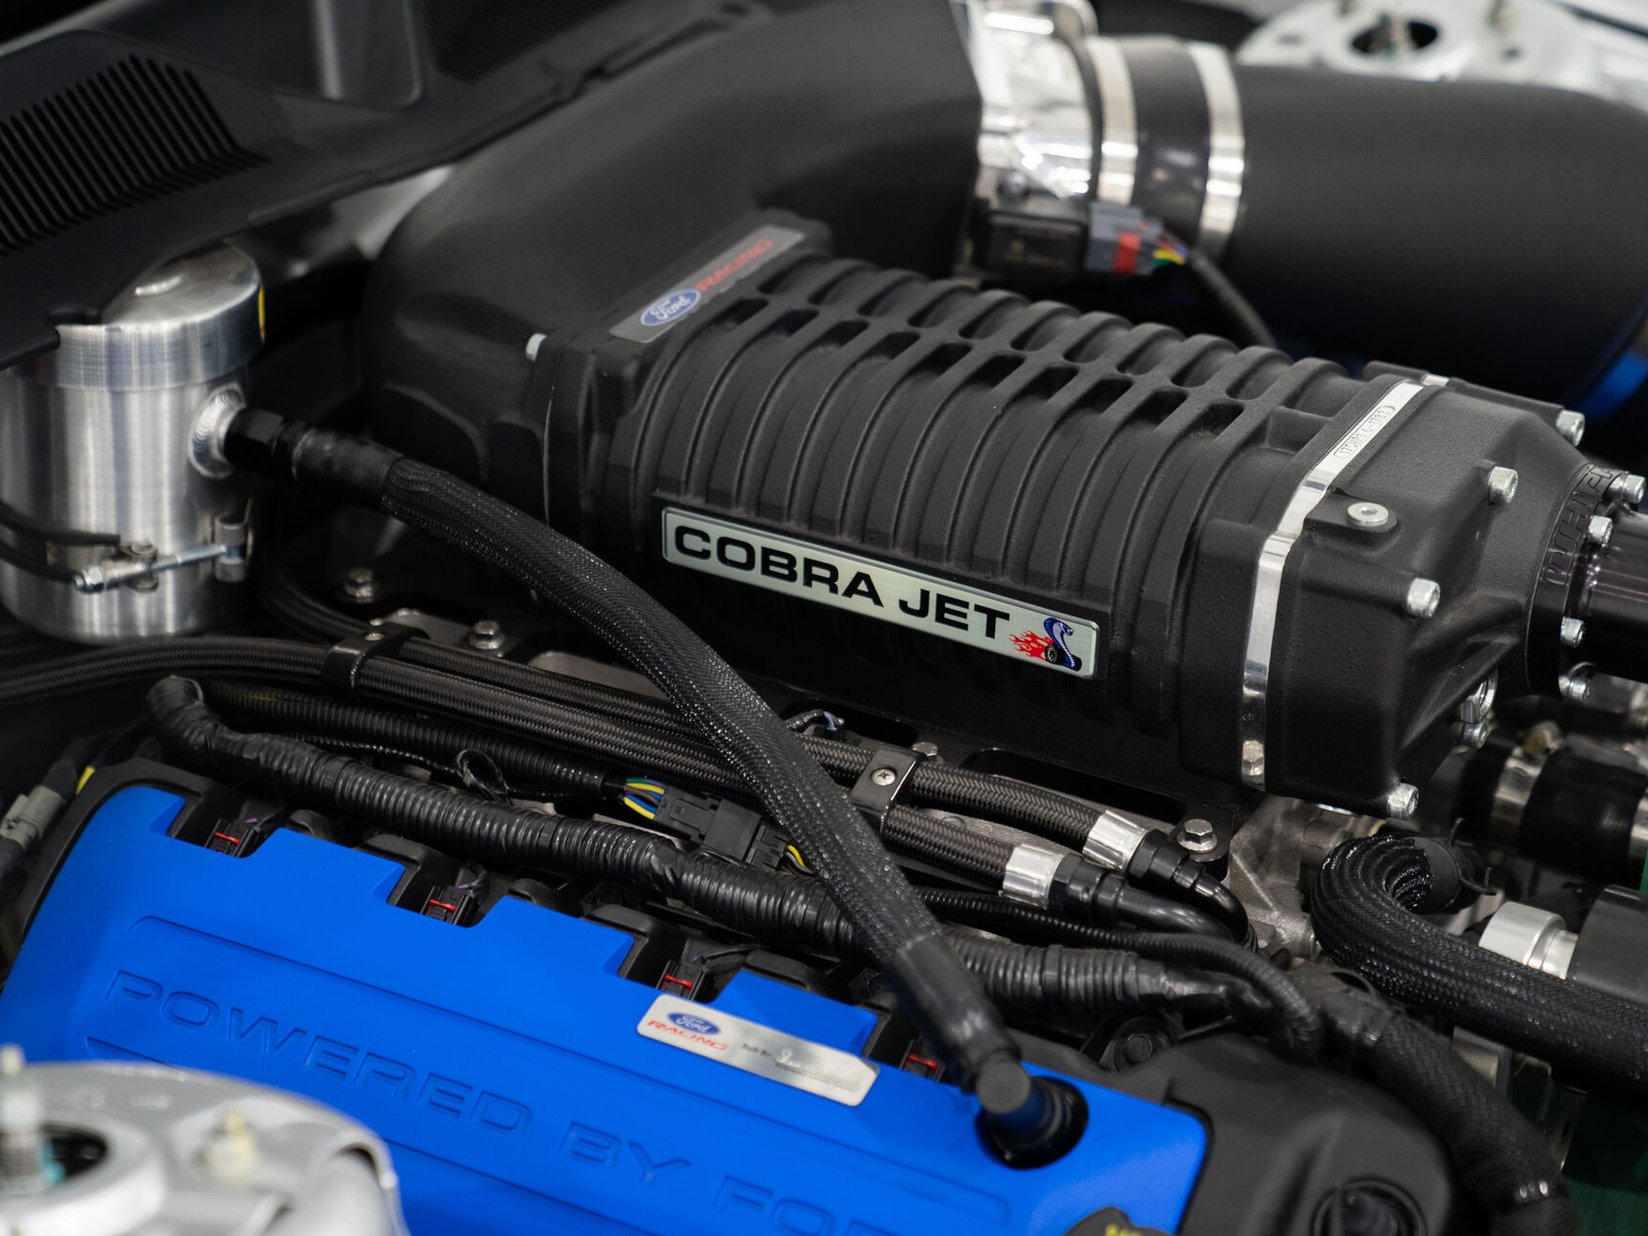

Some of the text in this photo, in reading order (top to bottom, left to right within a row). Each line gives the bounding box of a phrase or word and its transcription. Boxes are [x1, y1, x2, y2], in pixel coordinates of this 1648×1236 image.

[674, 525, 1010, 639] COBRA JET
[104, 969, 533, 1134] POWERED
[558, 1121, 691, 1183] BY
[645, 1020, 729, 1051] RACING
